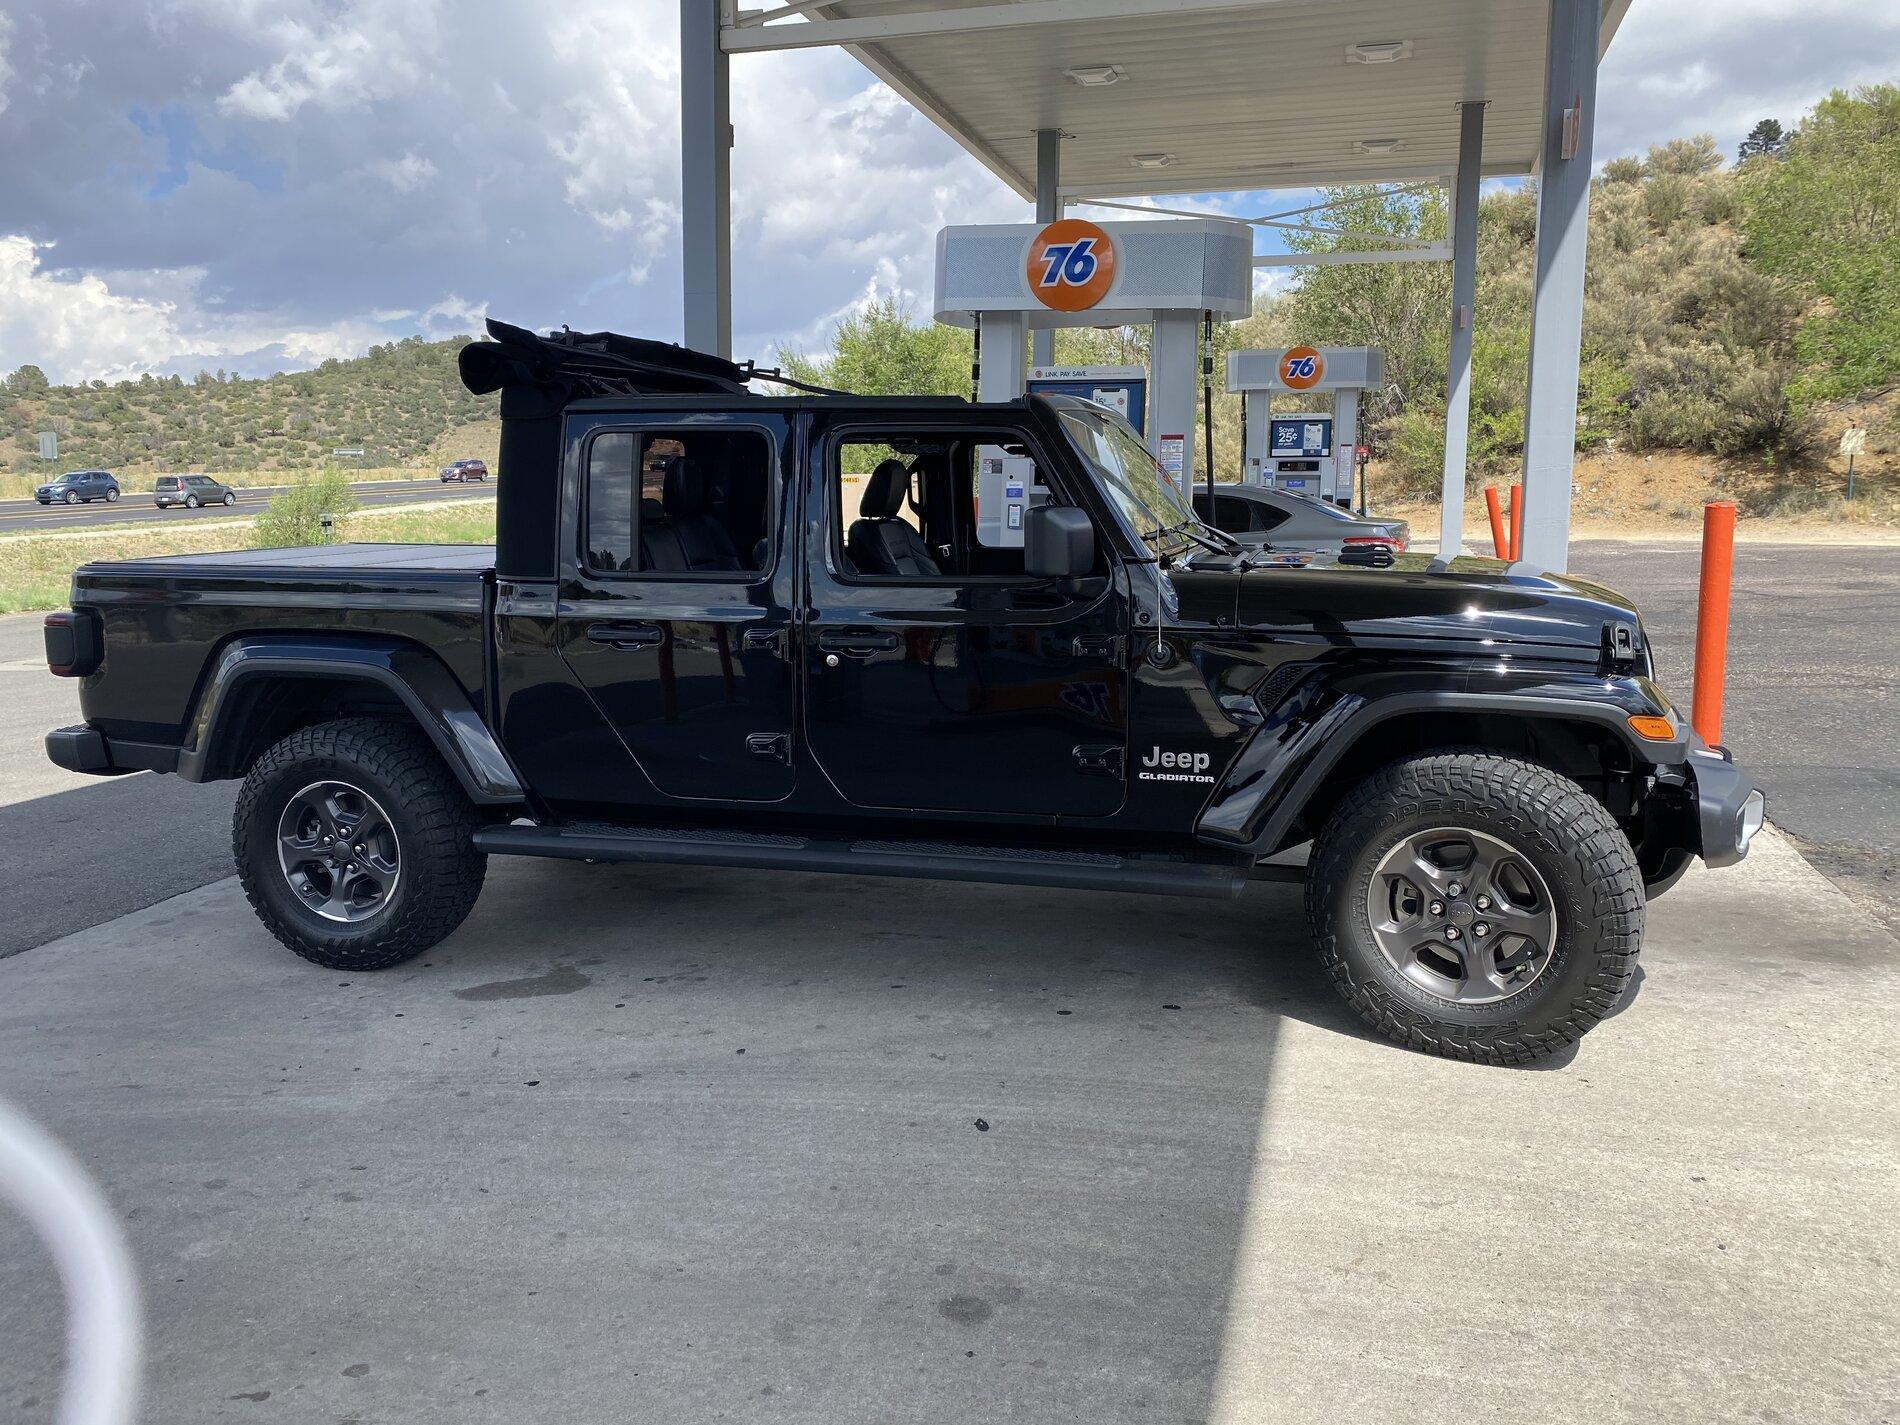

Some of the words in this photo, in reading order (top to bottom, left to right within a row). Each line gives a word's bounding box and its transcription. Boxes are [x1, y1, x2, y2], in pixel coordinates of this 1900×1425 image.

[1039, 237, 1098, 287] 76
[1286, 356, 1316, 379] 76
[1278, 432, 1298, 442] 25¢
[1142, 746, 1210, 773] Jeep
[1139, 772, 1215, 783] GLADIATOR
